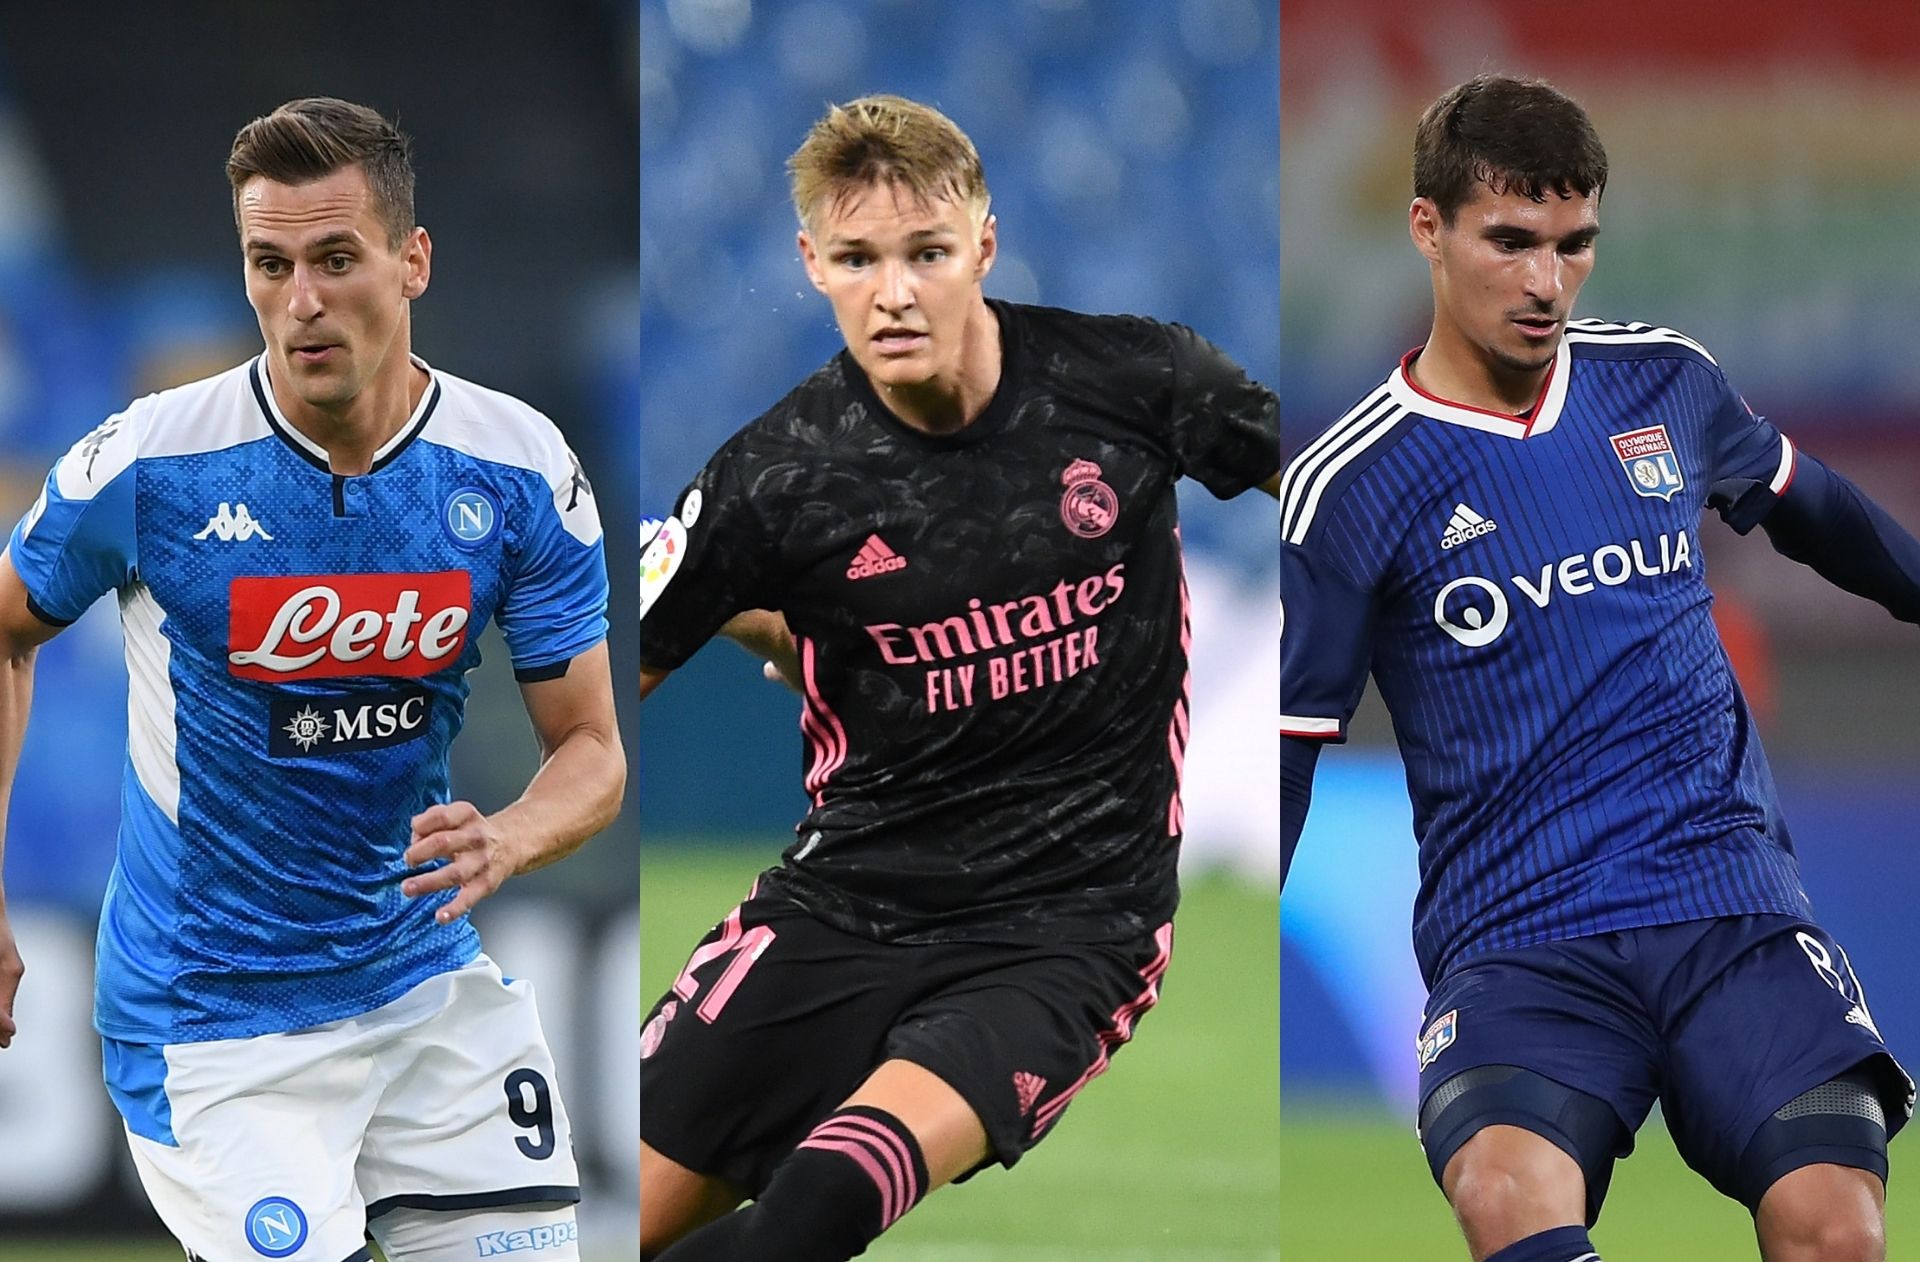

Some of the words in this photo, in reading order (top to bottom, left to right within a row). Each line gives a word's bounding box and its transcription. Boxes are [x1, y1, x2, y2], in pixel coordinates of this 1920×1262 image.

[1618, 432, 1663, 449] OLYMPIQUE
[1623, 441, 1667, 457] LYONNAIS
[457, 502, 483, 530] N
[1440, 518, 1497, 550] adidas
[846, 555, 907, 580] adidas
[1511, 530, 1692, 608] VEOLIA
[228, 586, 469, 671] Lete
[864, 563, 1125, 665] Emirates
[926, 664, 975, 714] FLY
[988, 625, 1100, 701] BETTER
[332, 696, 425, 743] MSC
[503, 1067, 556, 1161] 9
[259, 1210, 293, 1245] N
[476, 1221, 577, 1257] Kappa
